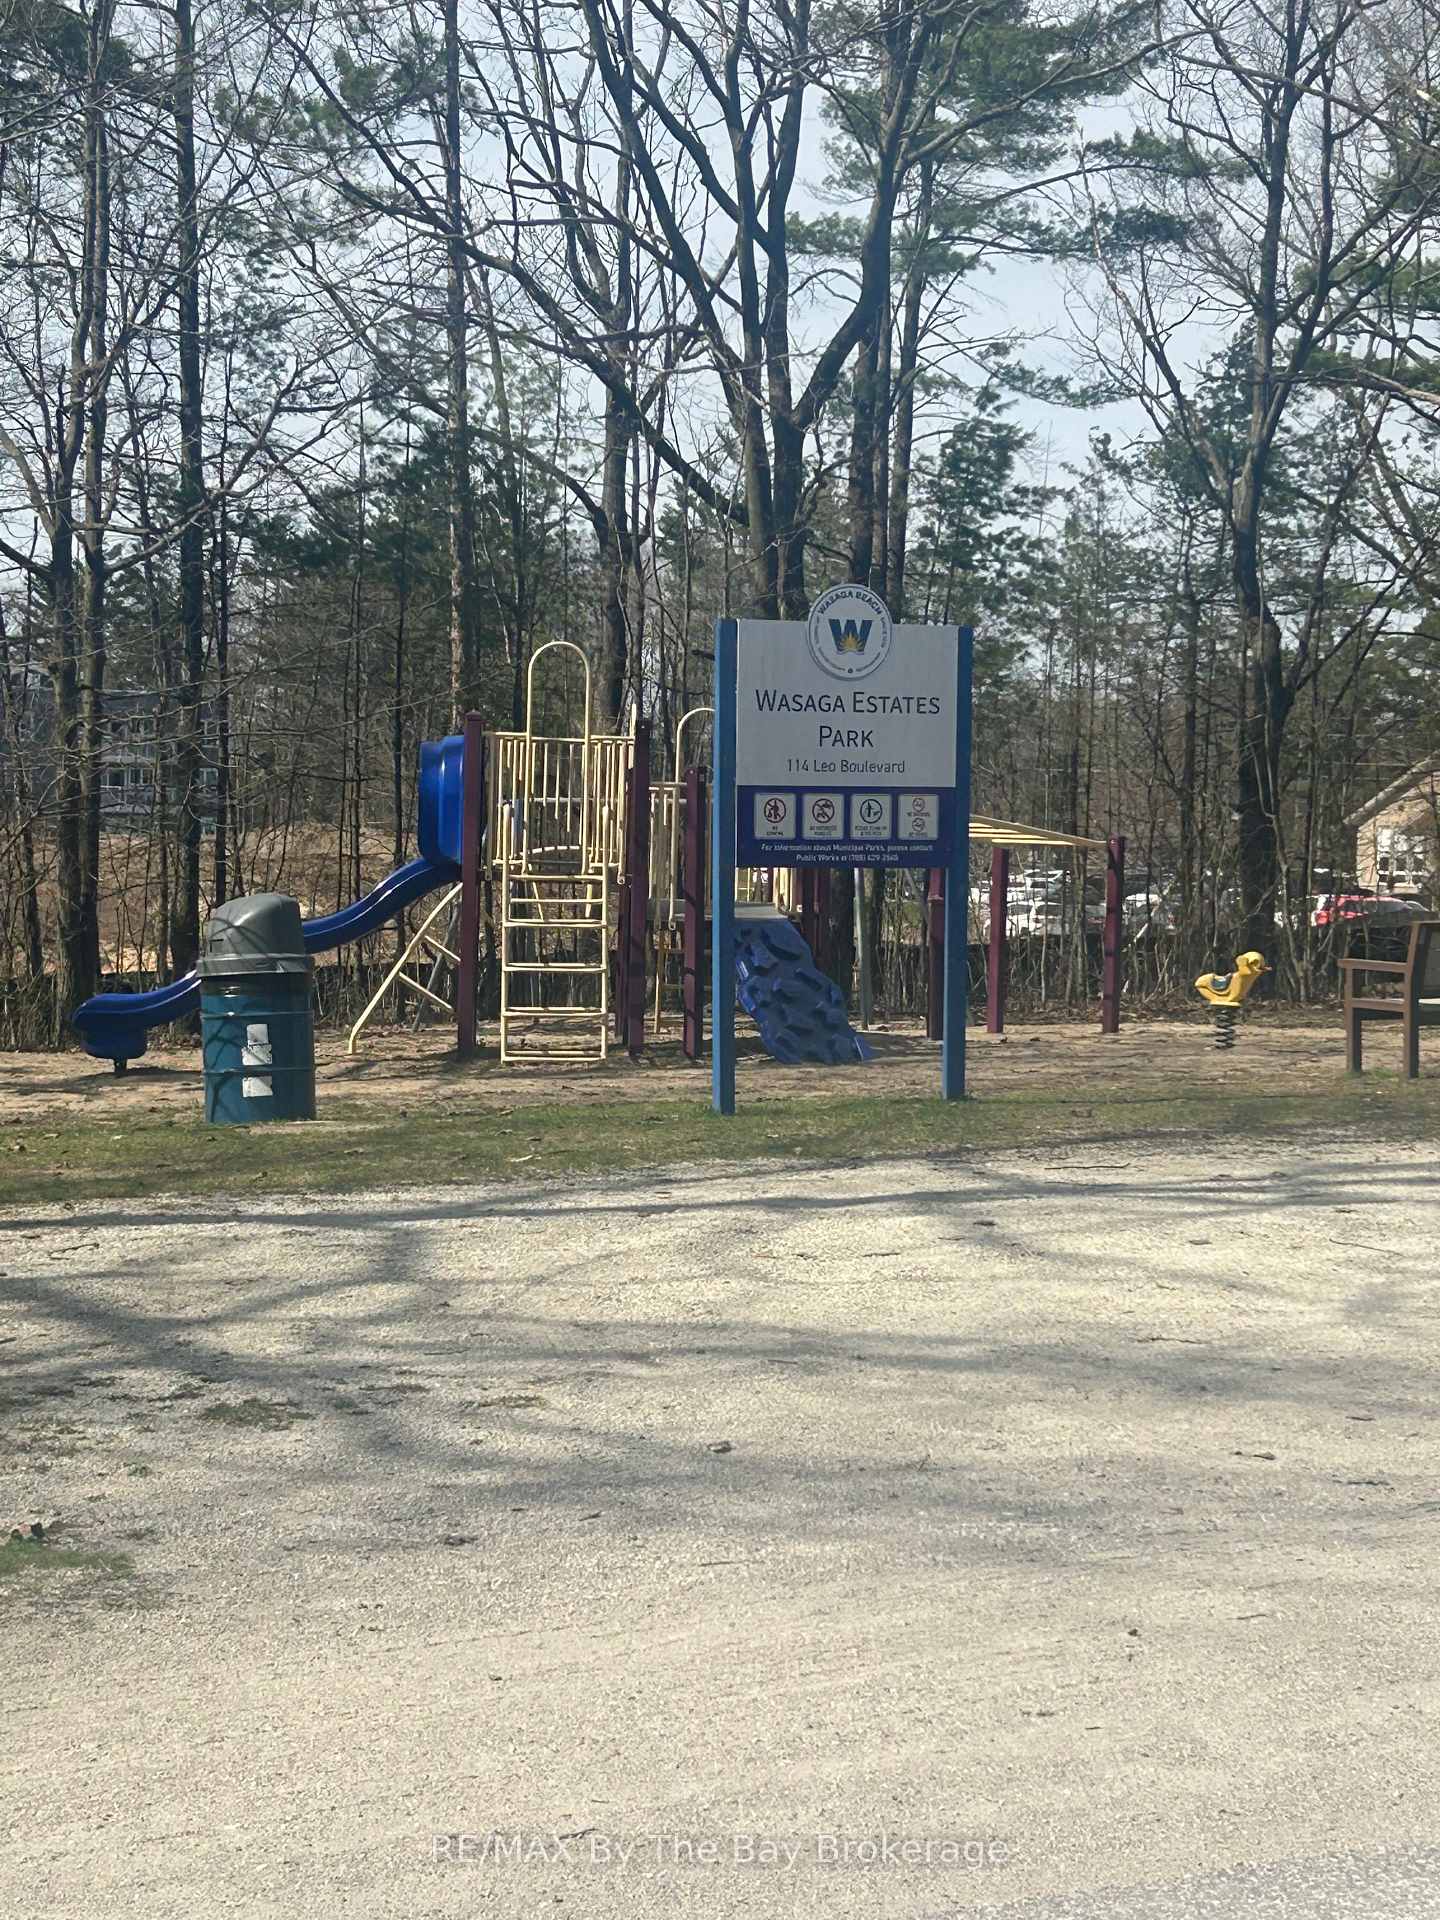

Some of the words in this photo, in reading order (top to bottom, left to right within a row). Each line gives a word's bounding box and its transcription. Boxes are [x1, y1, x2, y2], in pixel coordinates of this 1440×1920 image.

[818, 589, 853, 614] WASAGA
[856, 591, 882, 615] BEACH
[828, 618, 874, 656] W
[818, 725, 874, 748] PARK
[787, 759, 809, 773] 114
[813, 759, 836, 773] Leo
[840, 759, 905, 774] Boulevard
